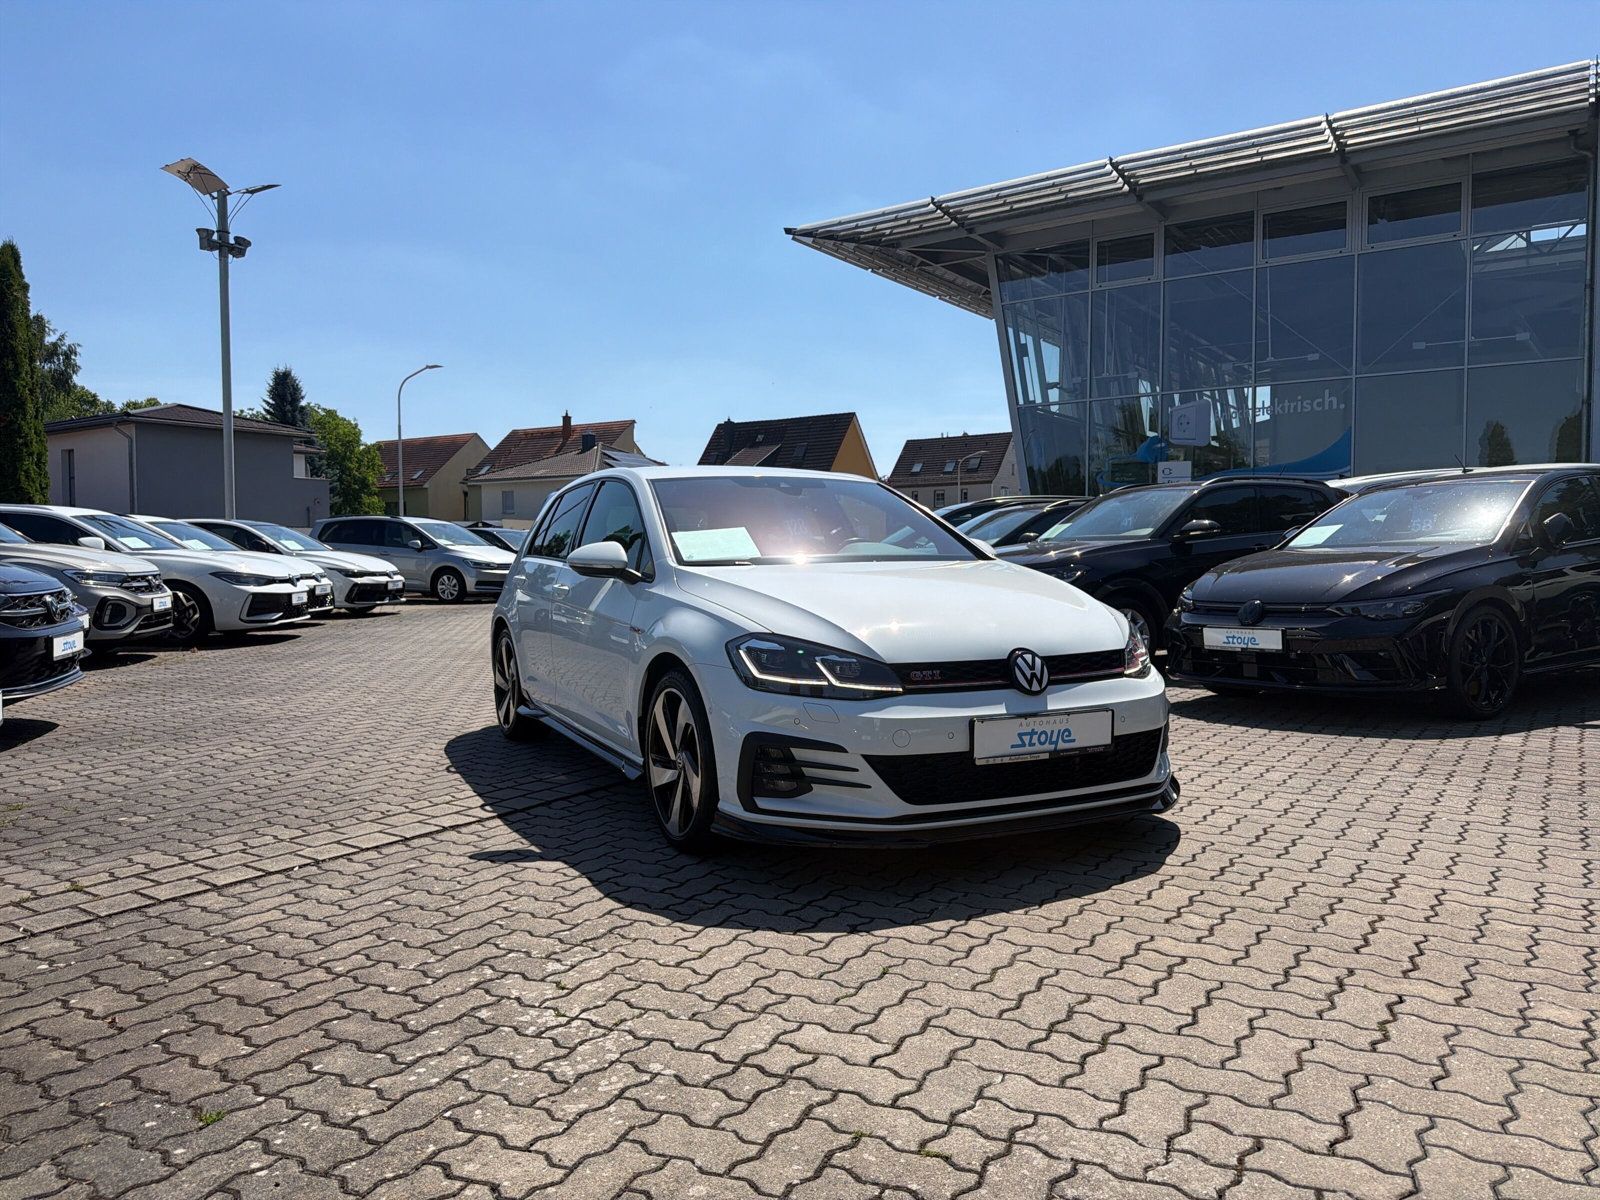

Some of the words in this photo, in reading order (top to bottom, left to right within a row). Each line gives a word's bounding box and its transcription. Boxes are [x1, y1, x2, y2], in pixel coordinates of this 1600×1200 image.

[1255, 389, 1346, 417] elektrisch.
[1222, 634, 1260, 649] stoye
[910, 669, 943, 681] GTI
[1018, 717, 1070, 728] AUTOHAUS
[1010, 727, 1077, 754] stoye
